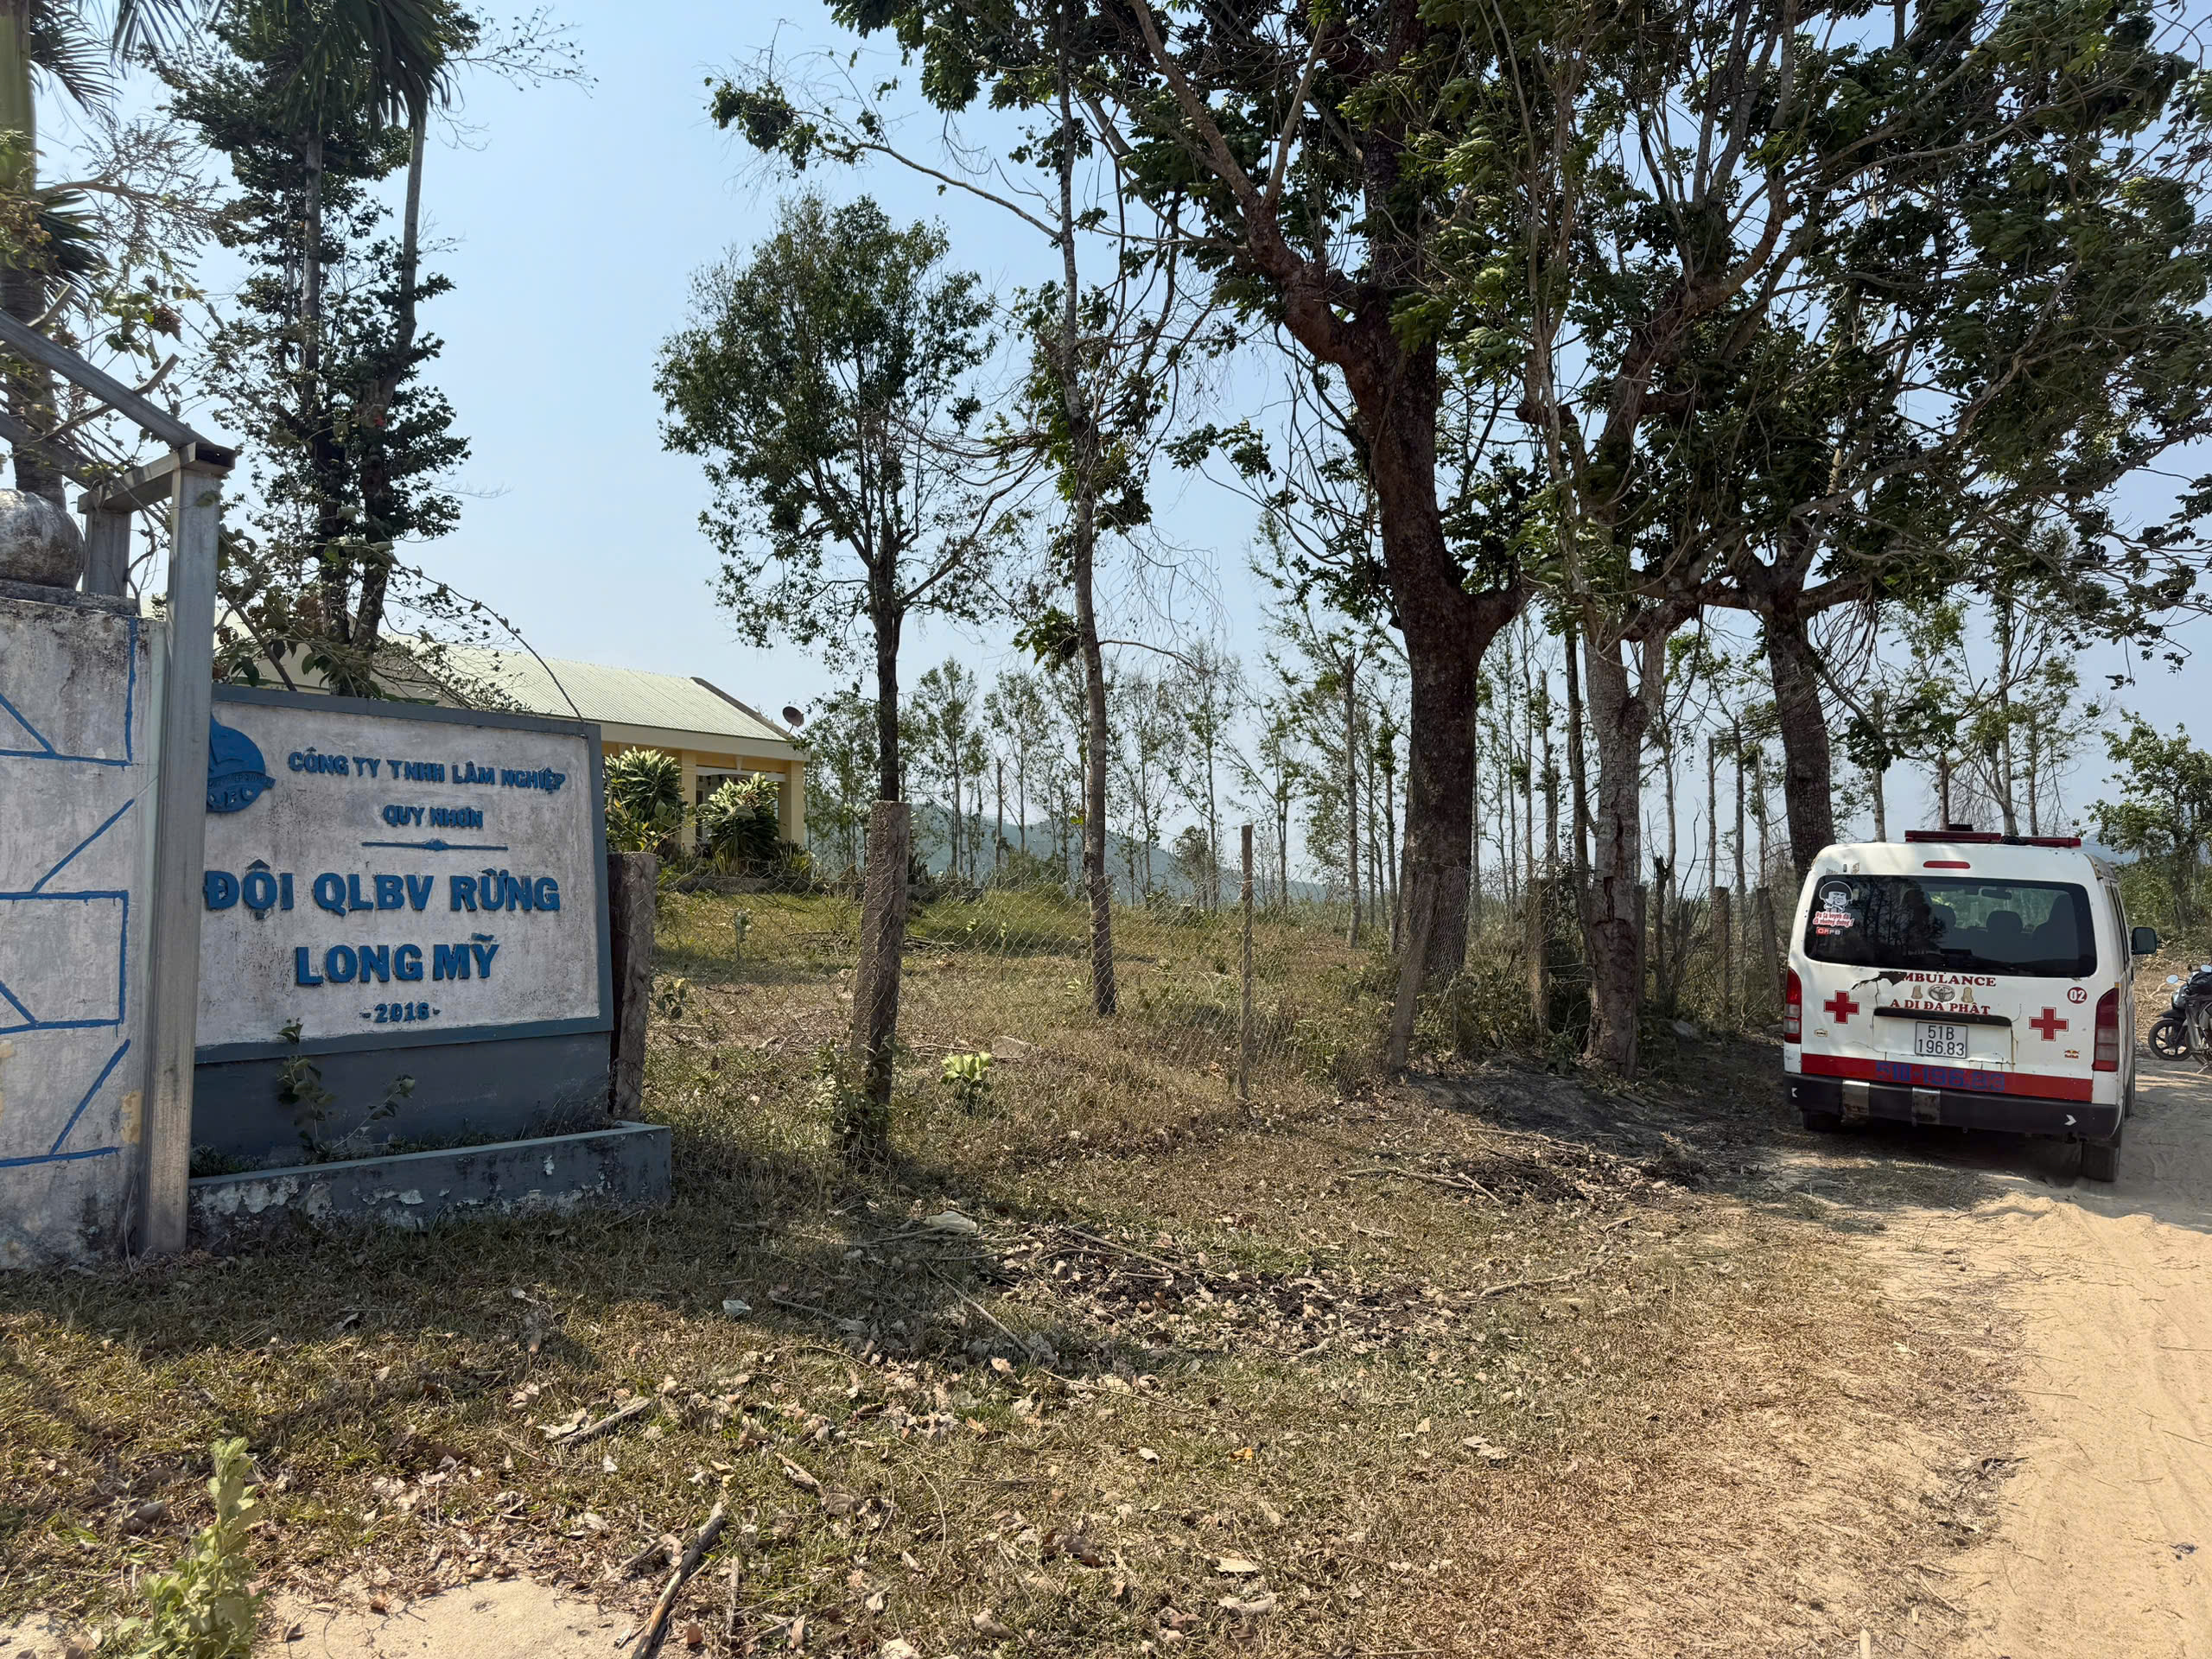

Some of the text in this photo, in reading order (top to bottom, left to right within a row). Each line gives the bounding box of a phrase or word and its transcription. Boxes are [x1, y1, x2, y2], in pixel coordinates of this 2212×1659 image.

[288, 747, 566, 794] CÔNG TY TNHH LÂM NGHIỆP
[383, 804, 483, 830] QUY NHƠN
[203, 859, 560, 920] ĐỘI QLBV RỪNG
[296, 932, 499, 985] LONG MỸ
[1901, 972, 1997, 987] MBULANCE
[1891, 999, 1901, 1008] A
[1904, 1000, 1920, 1009] DI
[2069, 989, 2086, 1001] 02
[1928, 1025, 1955, 1040] 51B
[1917, 1039, 1965, 1057] 196.83
